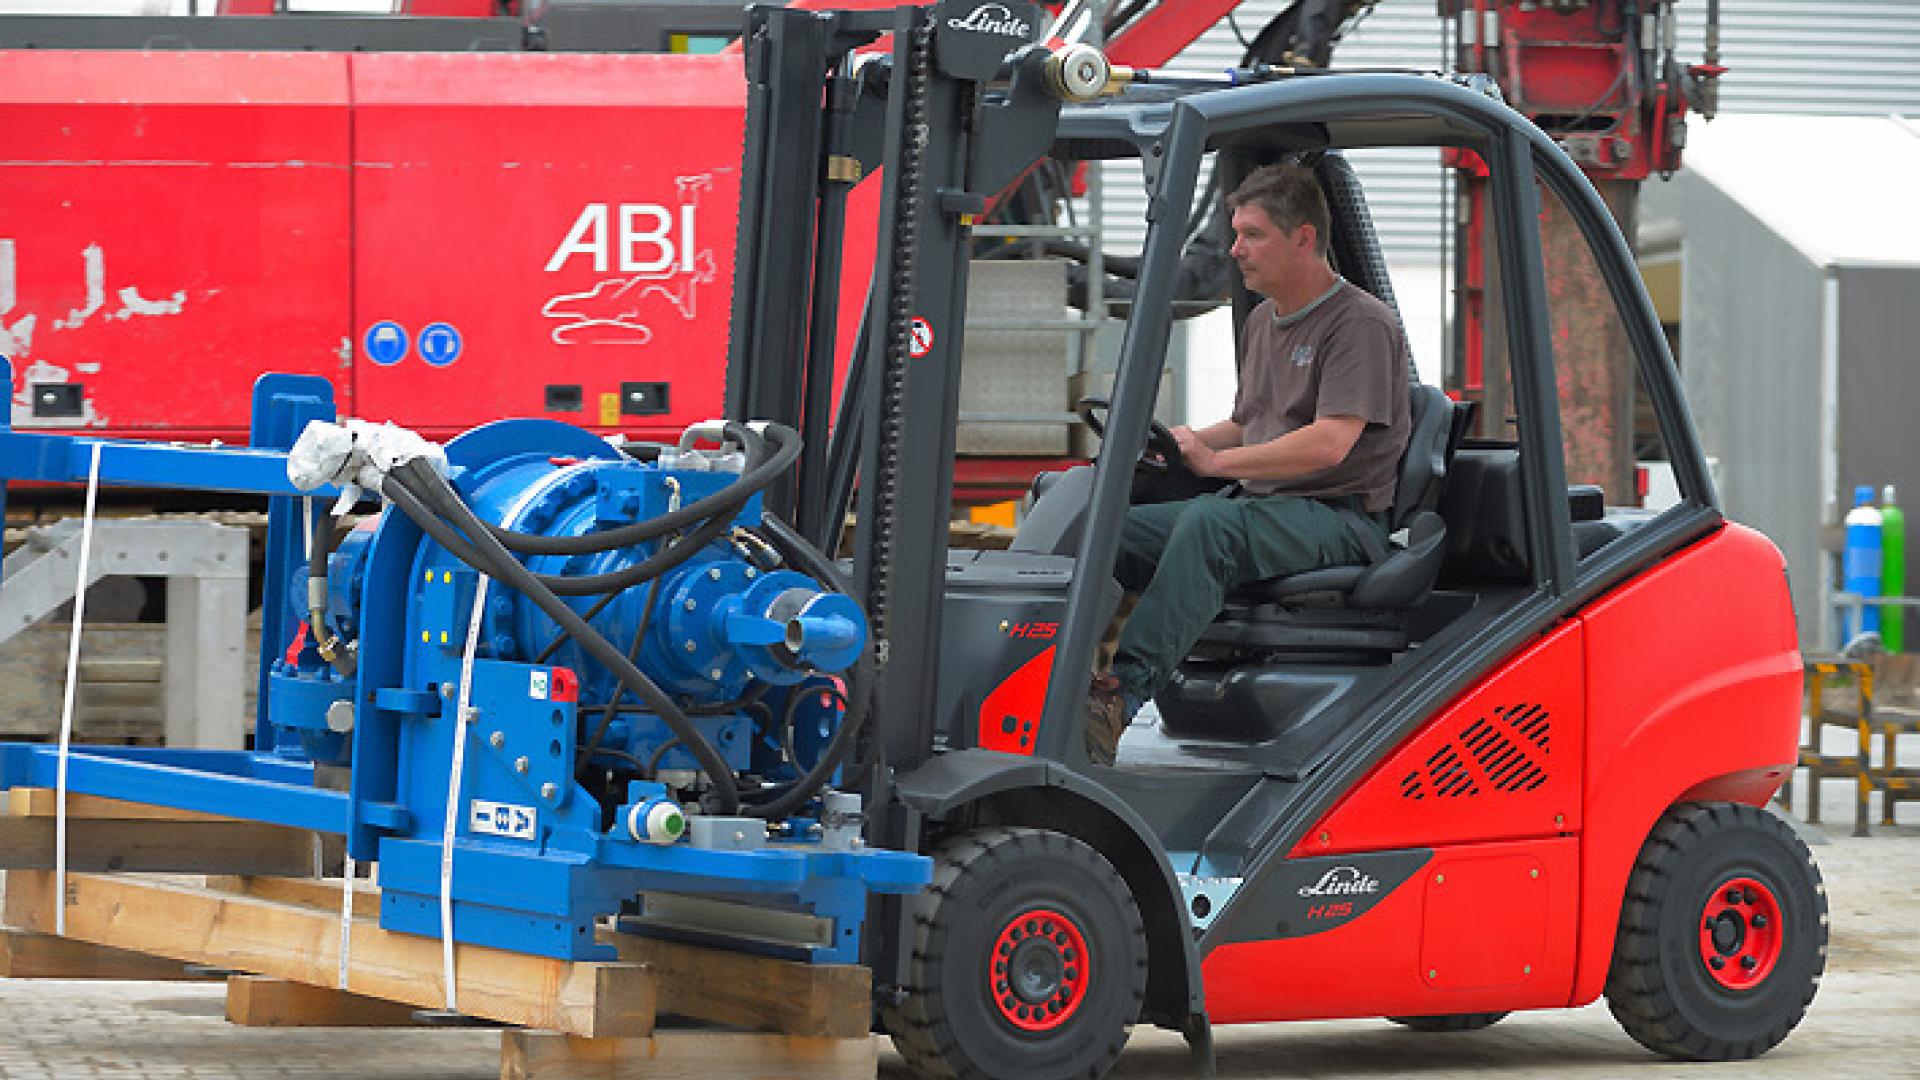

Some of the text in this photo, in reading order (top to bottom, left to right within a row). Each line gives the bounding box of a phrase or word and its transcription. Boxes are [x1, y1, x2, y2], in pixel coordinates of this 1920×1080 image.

[947, 3, 1030, 37] Linde
[543, 202, 695, 272] ABI
[1297, 866, 1379, 897] Linde
